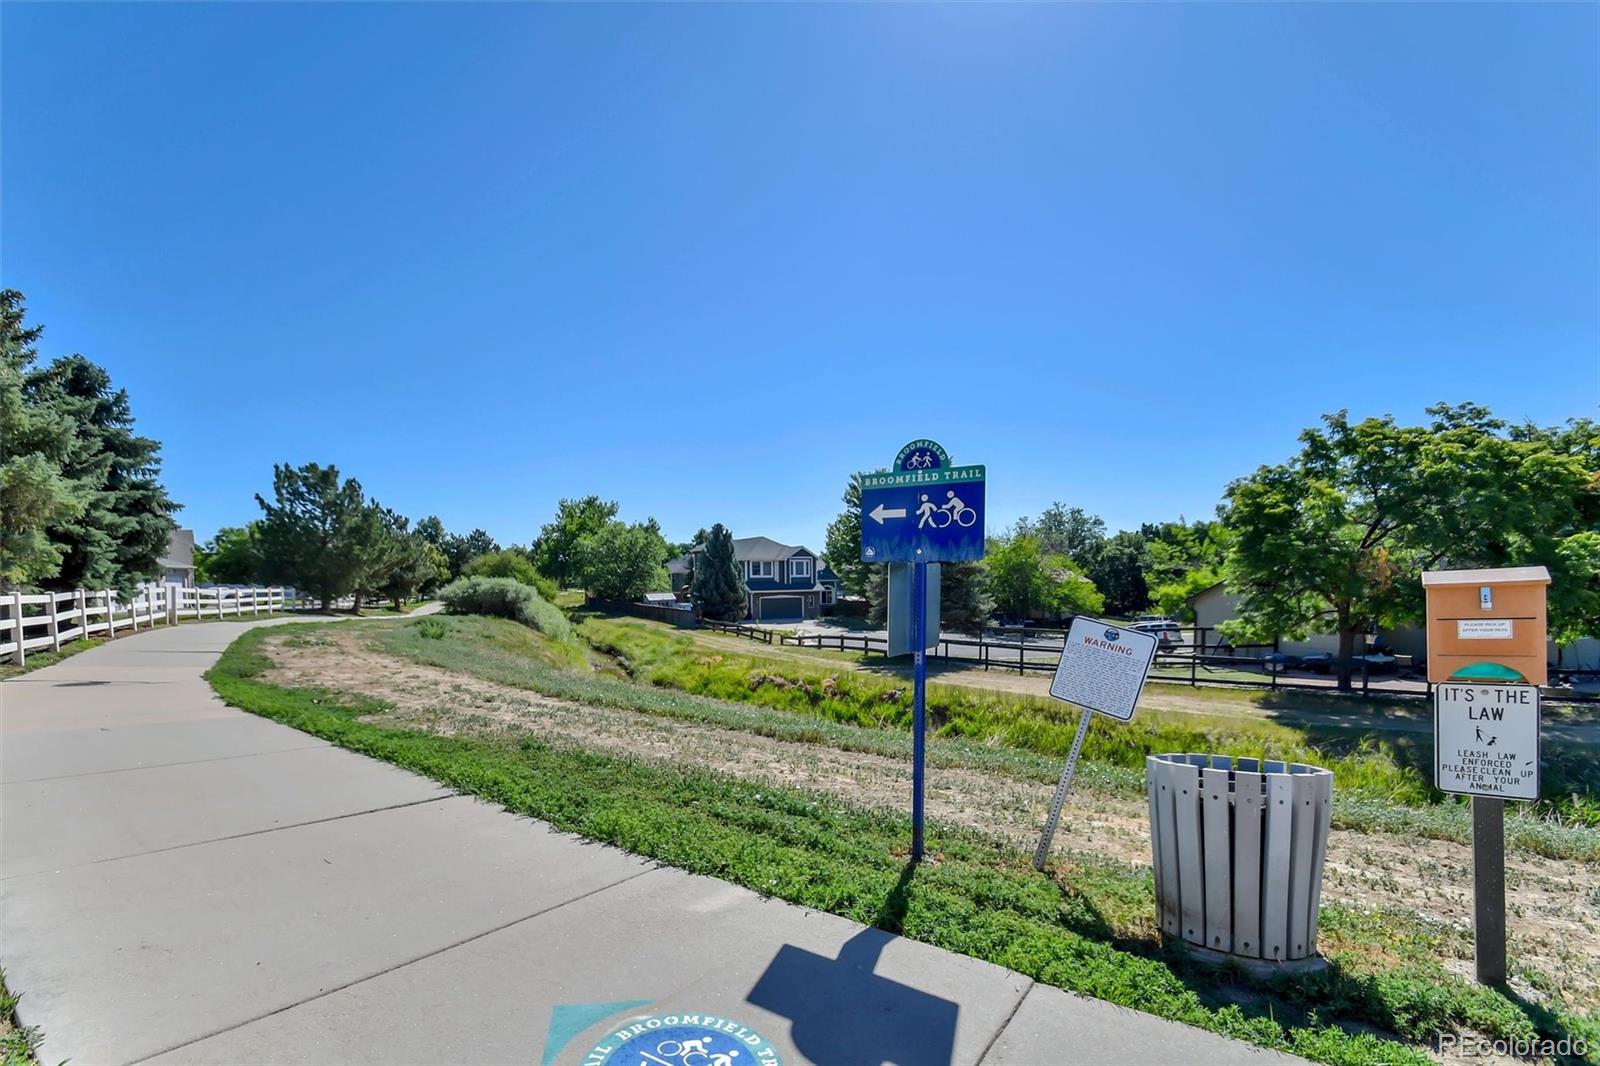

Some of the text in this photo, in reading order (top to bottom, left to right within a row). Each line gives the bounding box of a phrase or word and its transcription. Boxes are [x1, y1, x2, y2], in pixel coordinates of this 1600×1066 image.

[896, 440, 946, 465] BROOMFIELD
[865, 469, 982, 486] BROOMFIELD TRAIL
[1084, 636, 1133, 657] WARNING
[1445, 688, 1530, 705] IT'S THE
[1469, 706, 1504, 721] LAW
[1457, 749, 1517, 761] LEASH LAW
[1442, 763, 1534, 778] PLEASE CLEAN UP
[1462, 758, 1512, 769] ENFORCED
[1455, 773, 1520, 786] AFTER YOUR
[616, 1014, 761, 1046] BROOMFIELD
